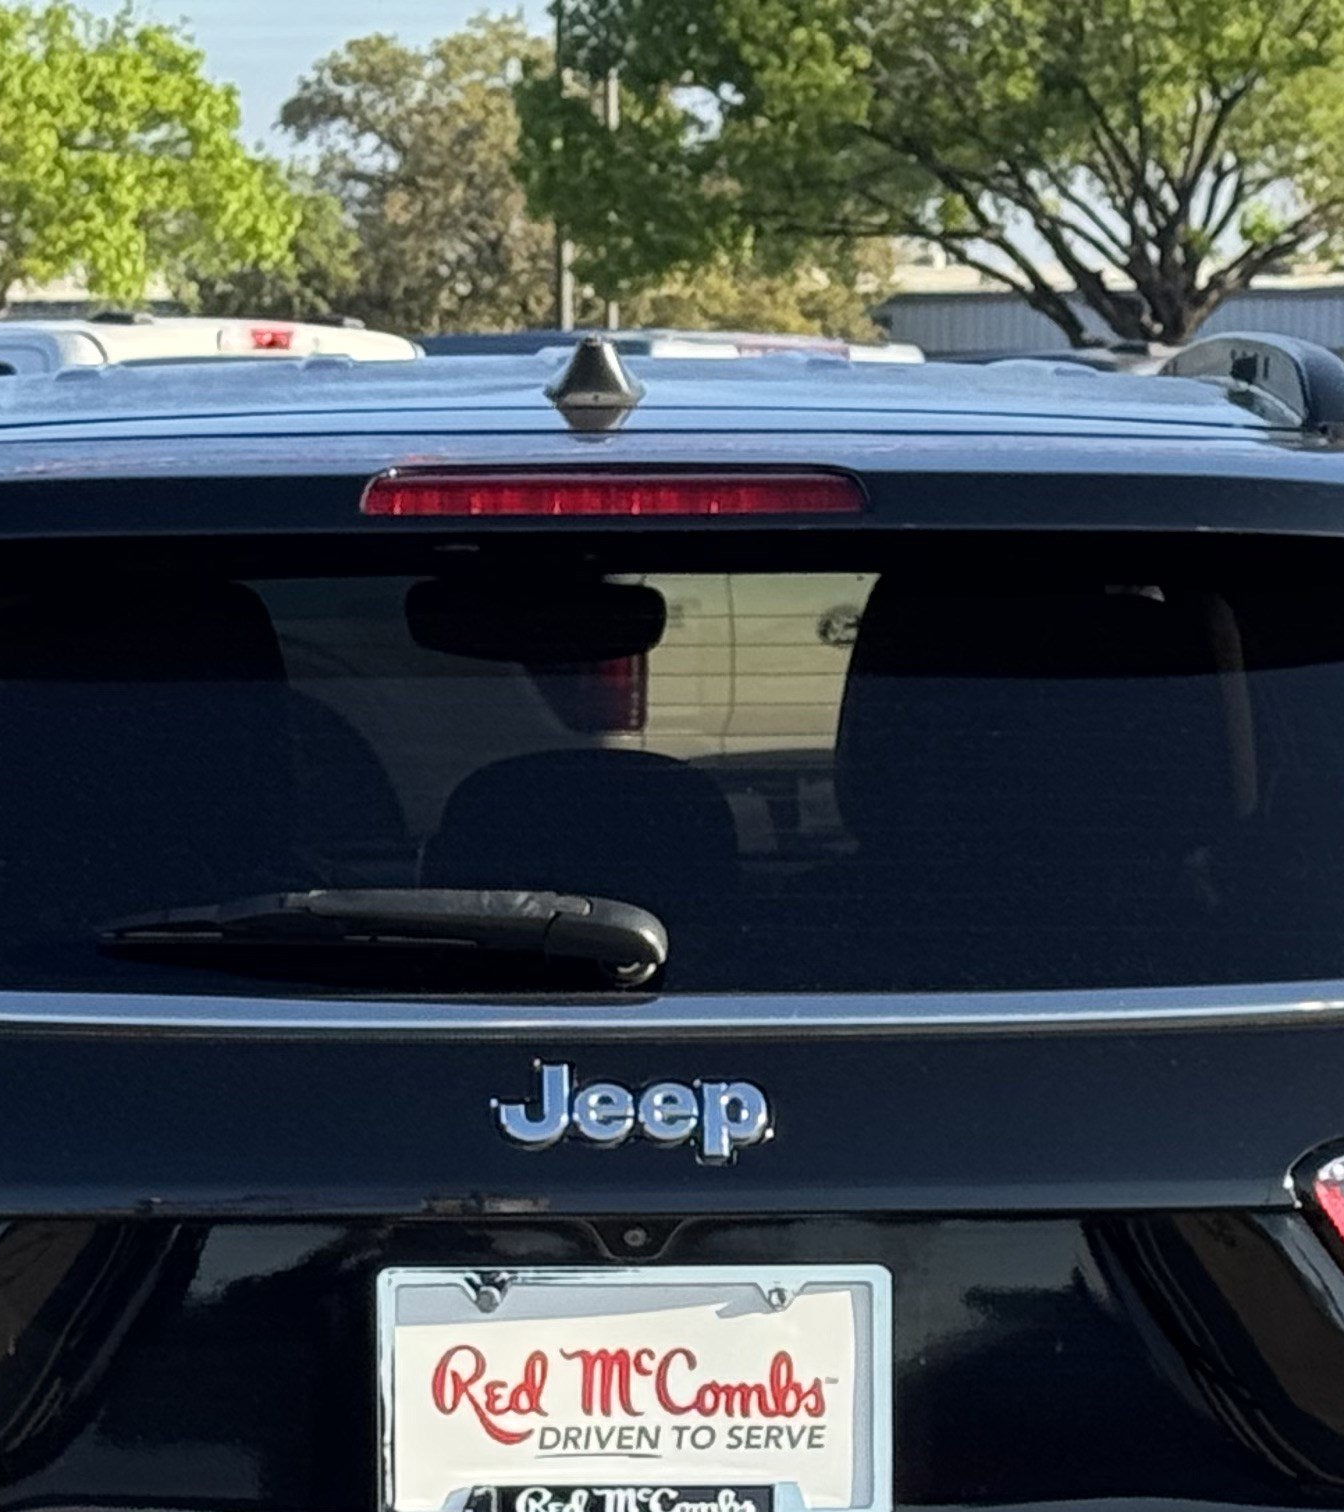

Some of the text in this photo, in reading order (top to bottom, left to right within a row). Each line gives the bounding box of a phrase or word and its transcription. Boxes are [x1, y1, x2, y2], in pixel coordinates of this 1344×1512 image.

[494, 1060, 773, 1164] Jeep
[431, 1344, 827, 1446] Red McCombs
[538, 1424, 827, 1451] DRIVEN TO SERVE
